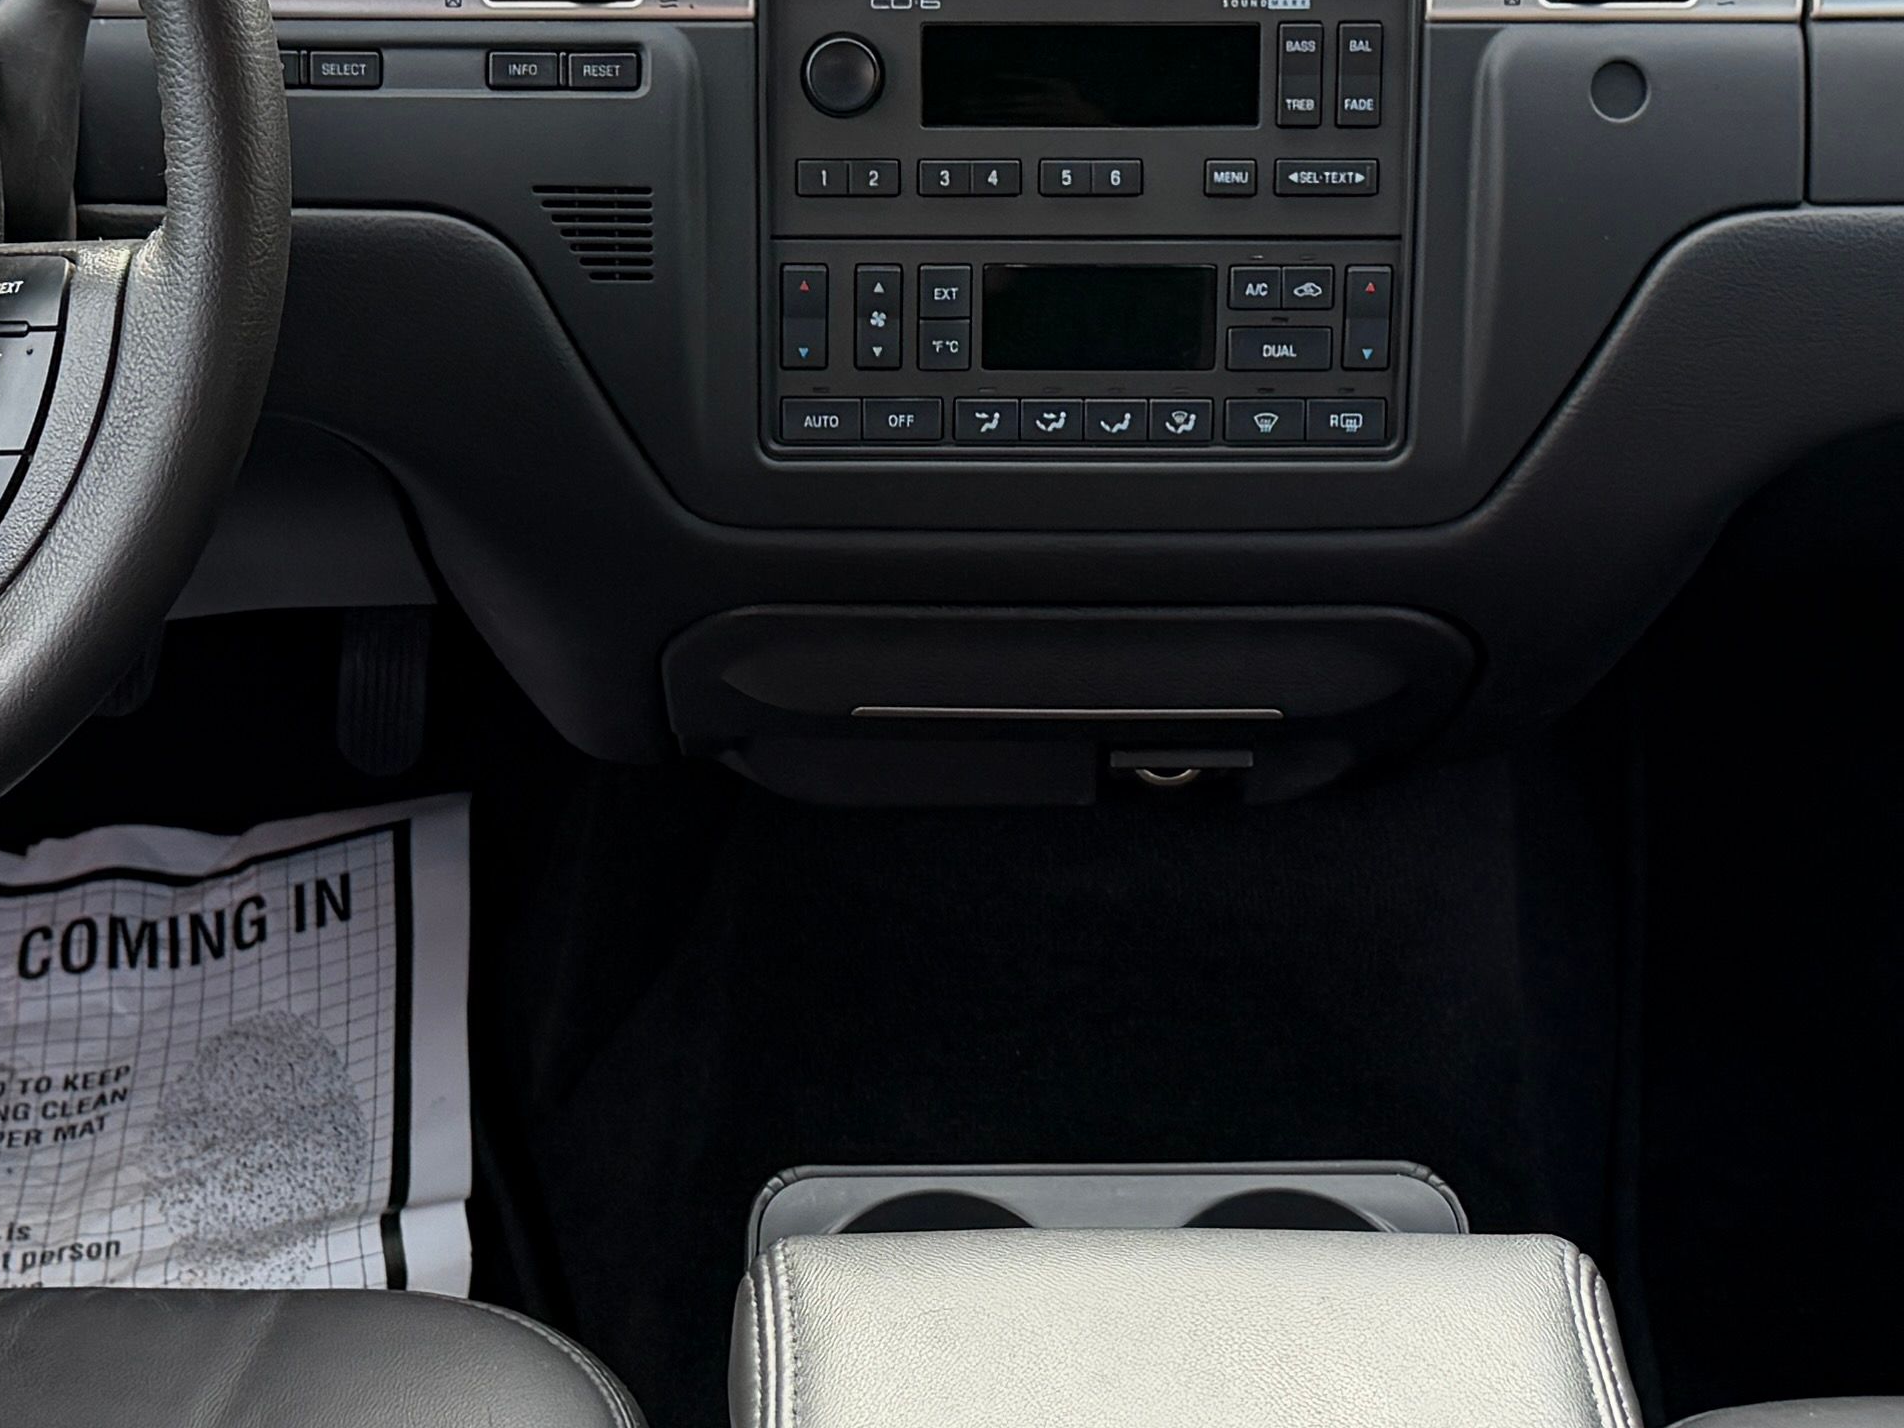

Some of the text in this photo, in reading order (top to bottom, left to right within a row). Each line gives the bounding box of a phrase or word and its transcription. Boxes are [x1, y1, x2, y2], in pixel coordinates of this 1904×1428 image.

[1285, 40, 1316, 52] BASS
[1349, 39, 1373, 52] BAL
[321, 62, 366, 77] SELECT
[508, 63, 538, 77] INFO
[582, 64, 621, 78] RESET
[1285, 98, 1315, 111] TREB
[1344, 98, 1374, 111] FADE
[821, 169, 827, 186] 1
[868, 169, 879, 186] 2
[939, 169, 950, 186] 3
[987, 169, 999, 186] 4
[1061, 169, 1072, 186] 5
[1110, 169, 1121, 186] 6
[1213, 171, 1249, 183] MENU
[933, 287, 959, 300] EXT
[1245, 282, 1269, 296] A/C
[1262, 344, 1297, 358] DUAL
[803, 415, 839, 428] AUTO
[888, 414, 915, 428] OFF
[17, 894, 267, 981] COMING
[295, 872, 351, 933] IN
[18, 1075, 52, 1095] TO
[63, 1064, 132, 1092] KEEP
[41, 1087, 129, 1121] CLEAN
[53, 1113, 110, 1143] MAT
[5, 1221, 32, 1242] is
[20, 1239, 122, 1270] person
